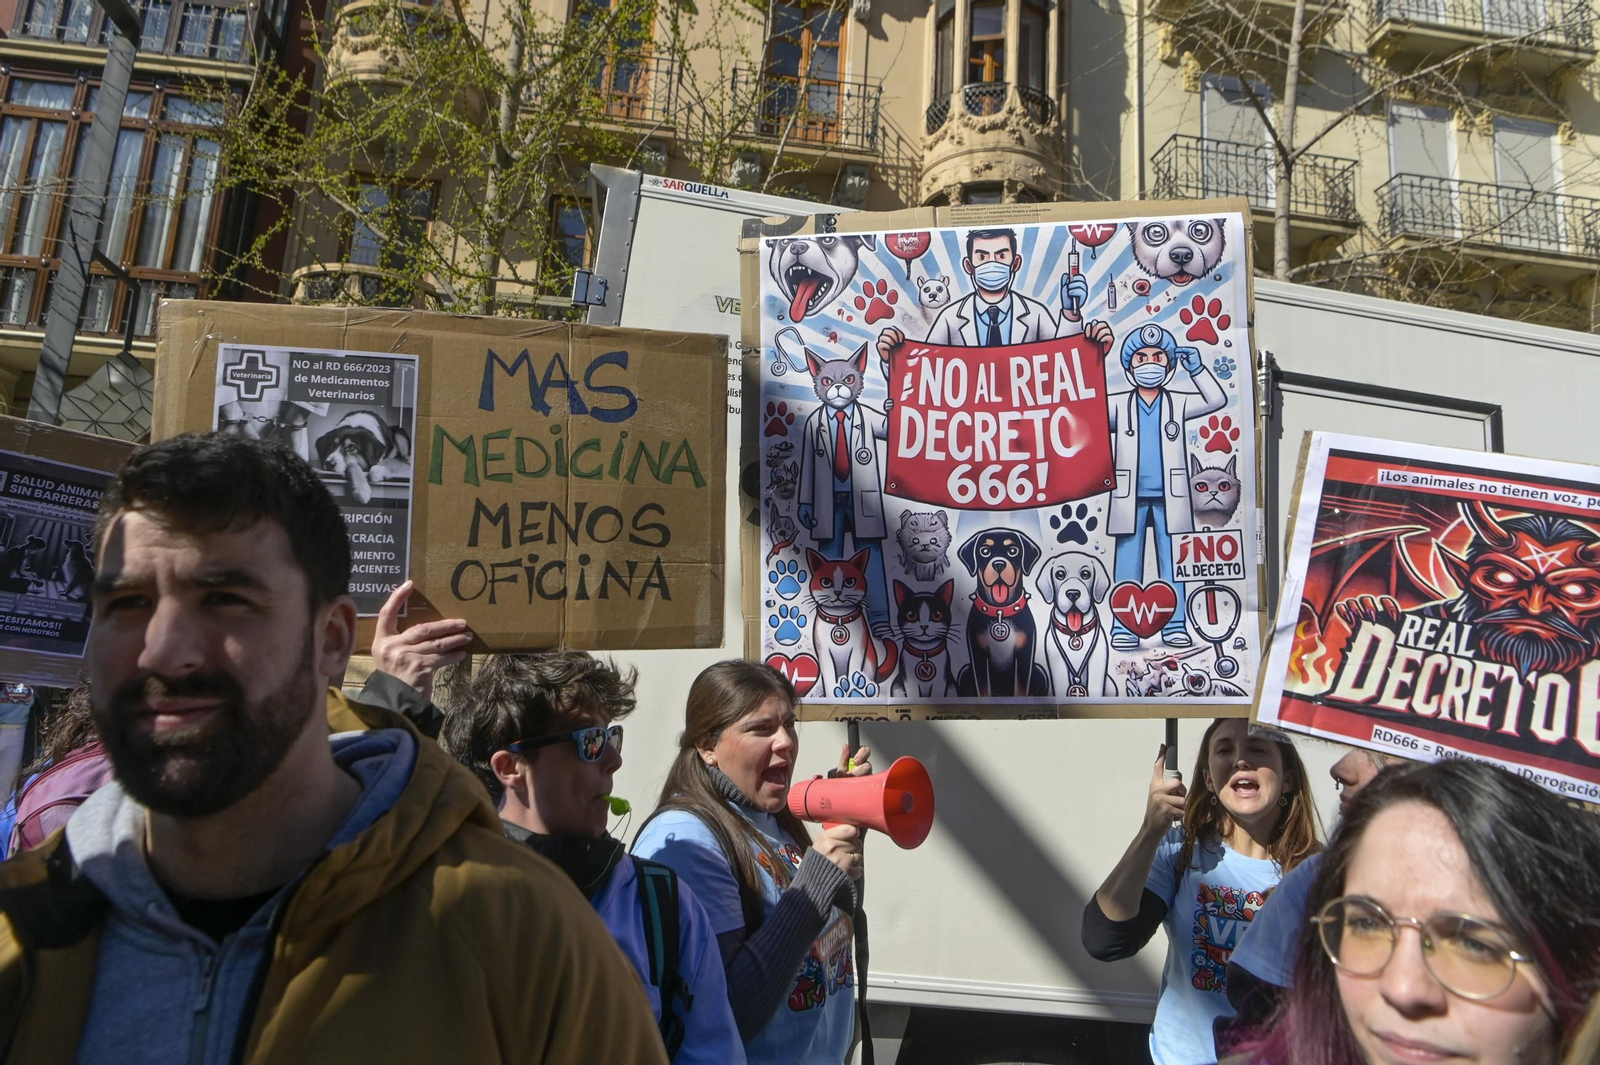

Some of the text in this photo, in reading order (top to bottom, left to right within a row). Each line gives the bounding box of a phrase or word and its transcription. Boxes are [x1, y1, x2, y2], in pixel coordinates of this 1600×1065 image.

[662, 178, 729, 199] SARQUELLA
[232, 371, 272, 380] Veterinaria
[292, 359, 391, 374] NO al RD 666/2023
[294, 373, 390, 388] de Medicamentos
[478, 348, 638, 423] MAS
[974, 362, 1002, 404] AL
[1009, 347, 1096, 408] REAL
[308, 388, 375, 401] Veterinarios
[12, 474, 55, 490] SALUD
[947, 461, 1049, 505] 666!
[1380, 471, 1409, 484] ¡Los
[1411, 473, 1476, 491] animales
[1479, 484, 1498, 494] no
[1501, 485, 1549, 500] tienen
[1553, 492, 1583, 506] voz,
[9, 484, 100, 509] SIN BARRERAS
[467, 497, 671, 549] MENOS
[351, 564, 401, 574] ACIENTES
[1176, 565, 1190, 578] AL
[348, 582, 398, 593] BUSIVAS
[21, 627, 60, 637] NOSOTROS
[1397, 613, 1475, 658] REAL
[1326, 619, 1571, 745] DECRETO
[1373, 729, 1419, 750] RD666
[820, 919, 848, 957] UNIDOS
